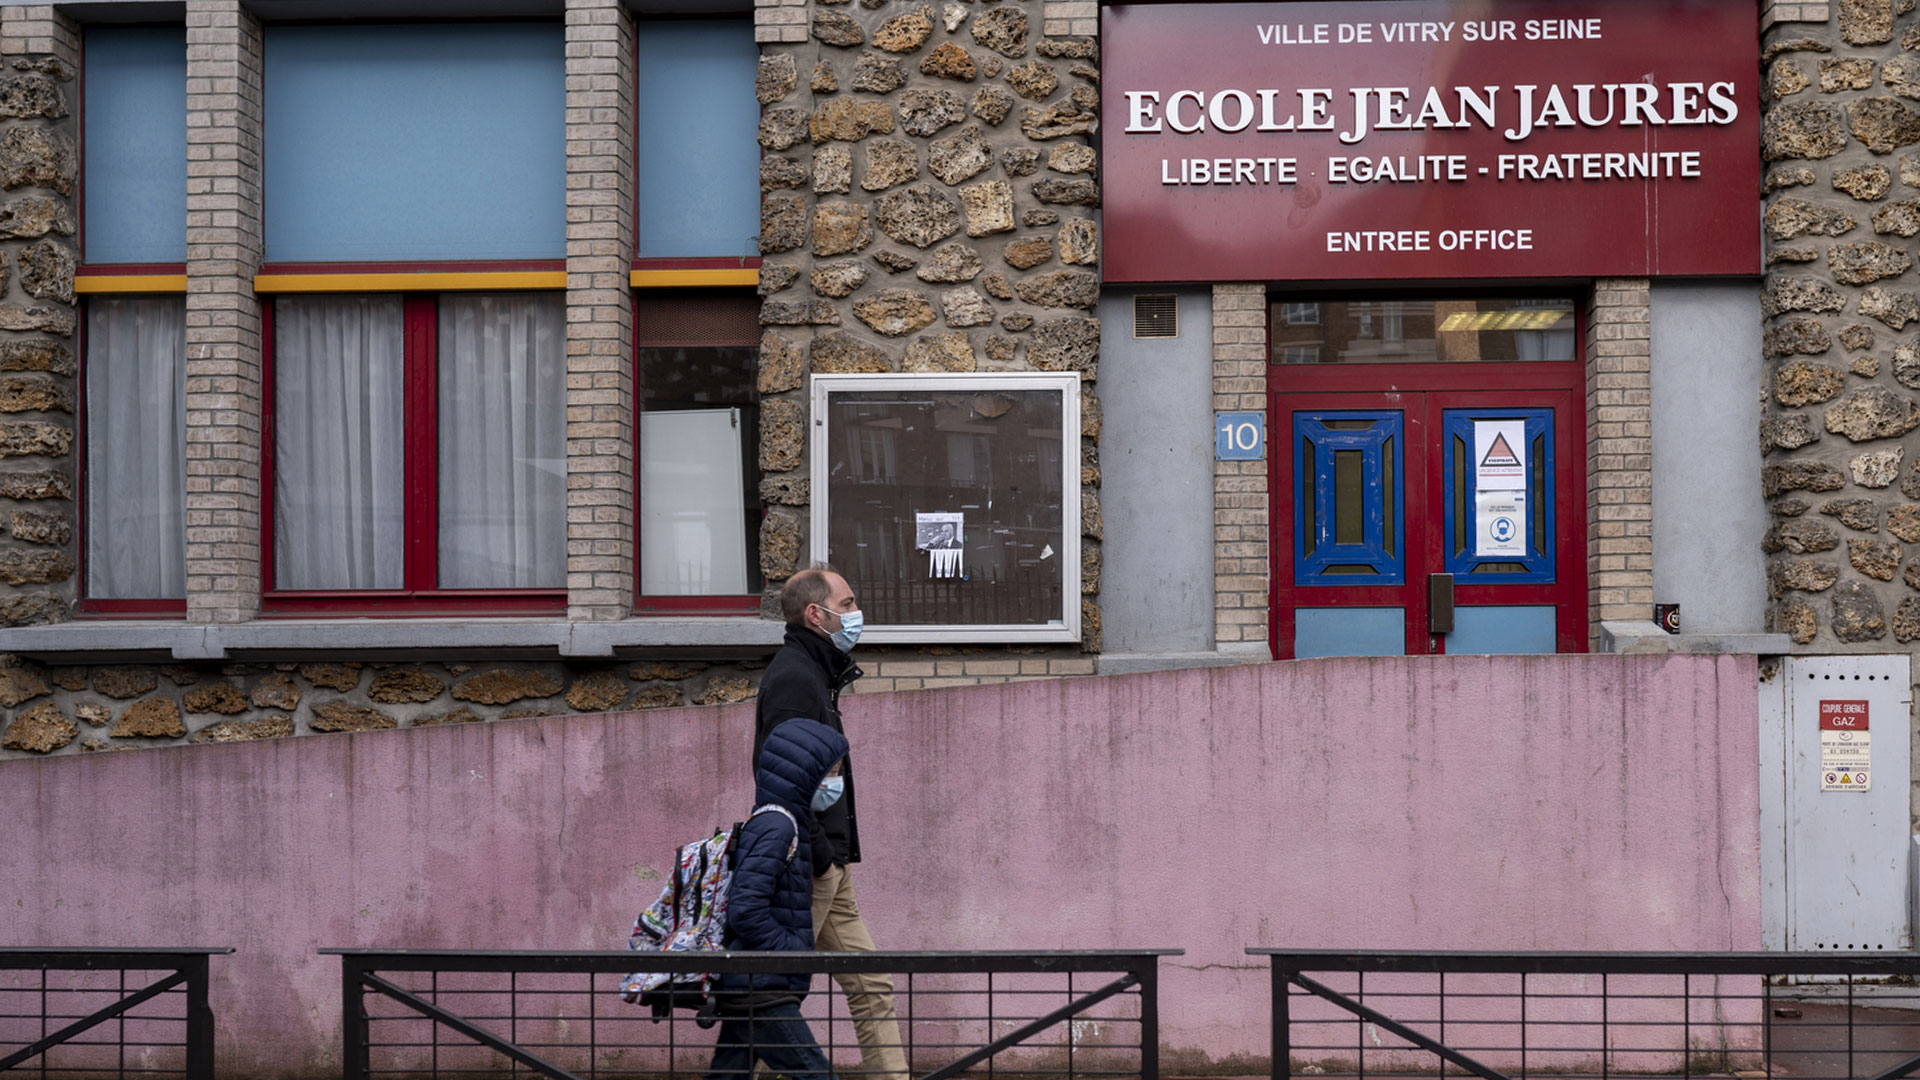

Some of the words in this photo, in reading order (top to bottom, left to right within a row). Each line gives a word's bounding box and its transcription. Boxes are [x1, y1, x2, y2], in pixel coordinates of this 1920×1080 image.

[1256, 23, 1330, 45] VILLE
[1338, 23, 1373, 44] DE
[1379, 21, 1455, 43] VITRY
[1462, 20, 1517, 41] SUR
[1524, 18, 1602, 40] SEINE
[1124, 88, 1335, 132] ECOLE
[1339, 85, 1500, 143] JEAN
[1504, 81, 1739, 141] JAURES
[1161, 157, 1298, 184] LIBERTE
[1328, 155, 1467, 182] EGALITE
[1498, 151, 1701, 179] FRATERNITE
[1326, 230, 1431, 252] ENTREE
[1438, 229, 1533, 251] OFFICE
[1221, 423, 1258, 450] 10
[1832, 716, 1855, 726] GAZ
